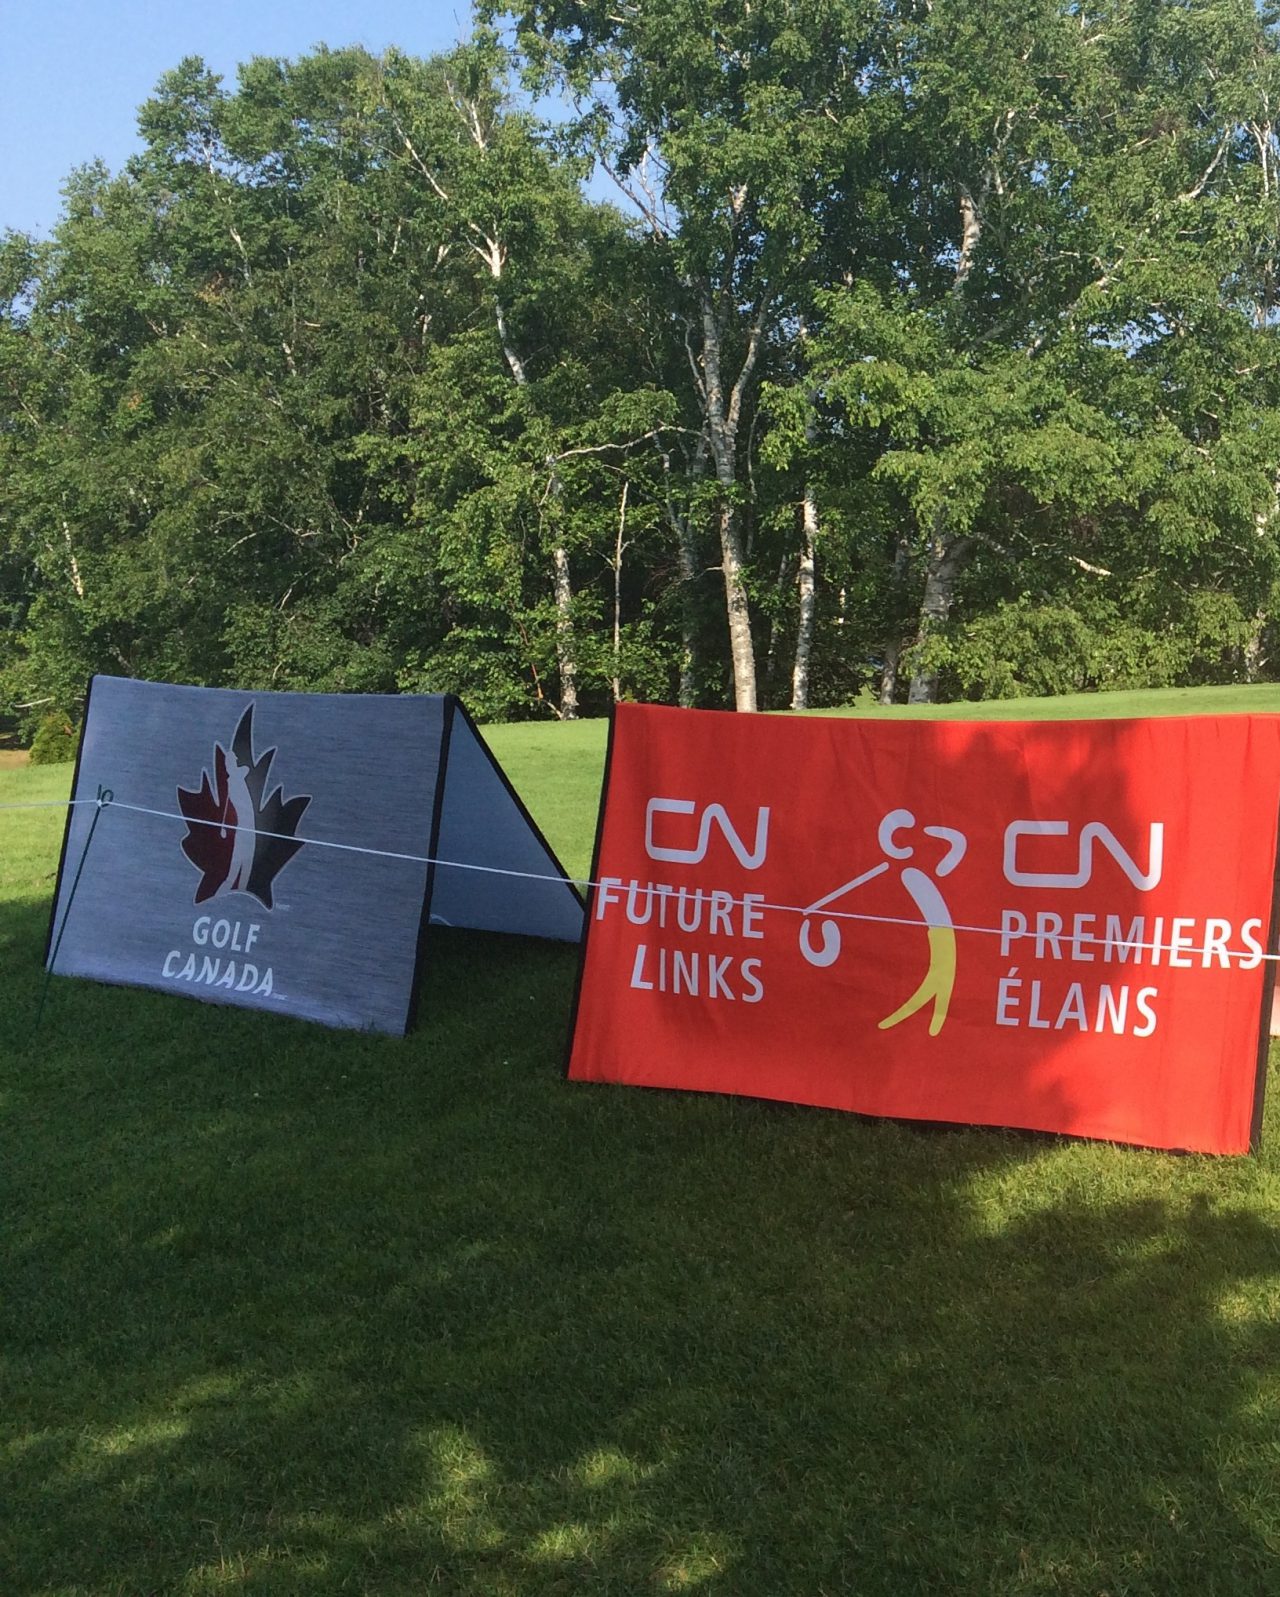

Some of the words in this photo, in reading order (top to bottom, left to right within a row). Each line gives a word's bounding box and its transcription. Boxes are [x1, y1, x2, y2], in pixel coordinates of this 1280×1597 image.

[645, 797, 770, 870] CN
[1003, 820, 1163, 891] CN
[192, 916, 261, 953] GOLF
[596, 877, 765, 939] FUTURE
[1000, 909, 1263, 970] PREMIERS
[161, 950, 274, 997] CANADA
[630, 944, 764, 1003] LINKS
[995, 967, 1158, 1038] ÉLANS
